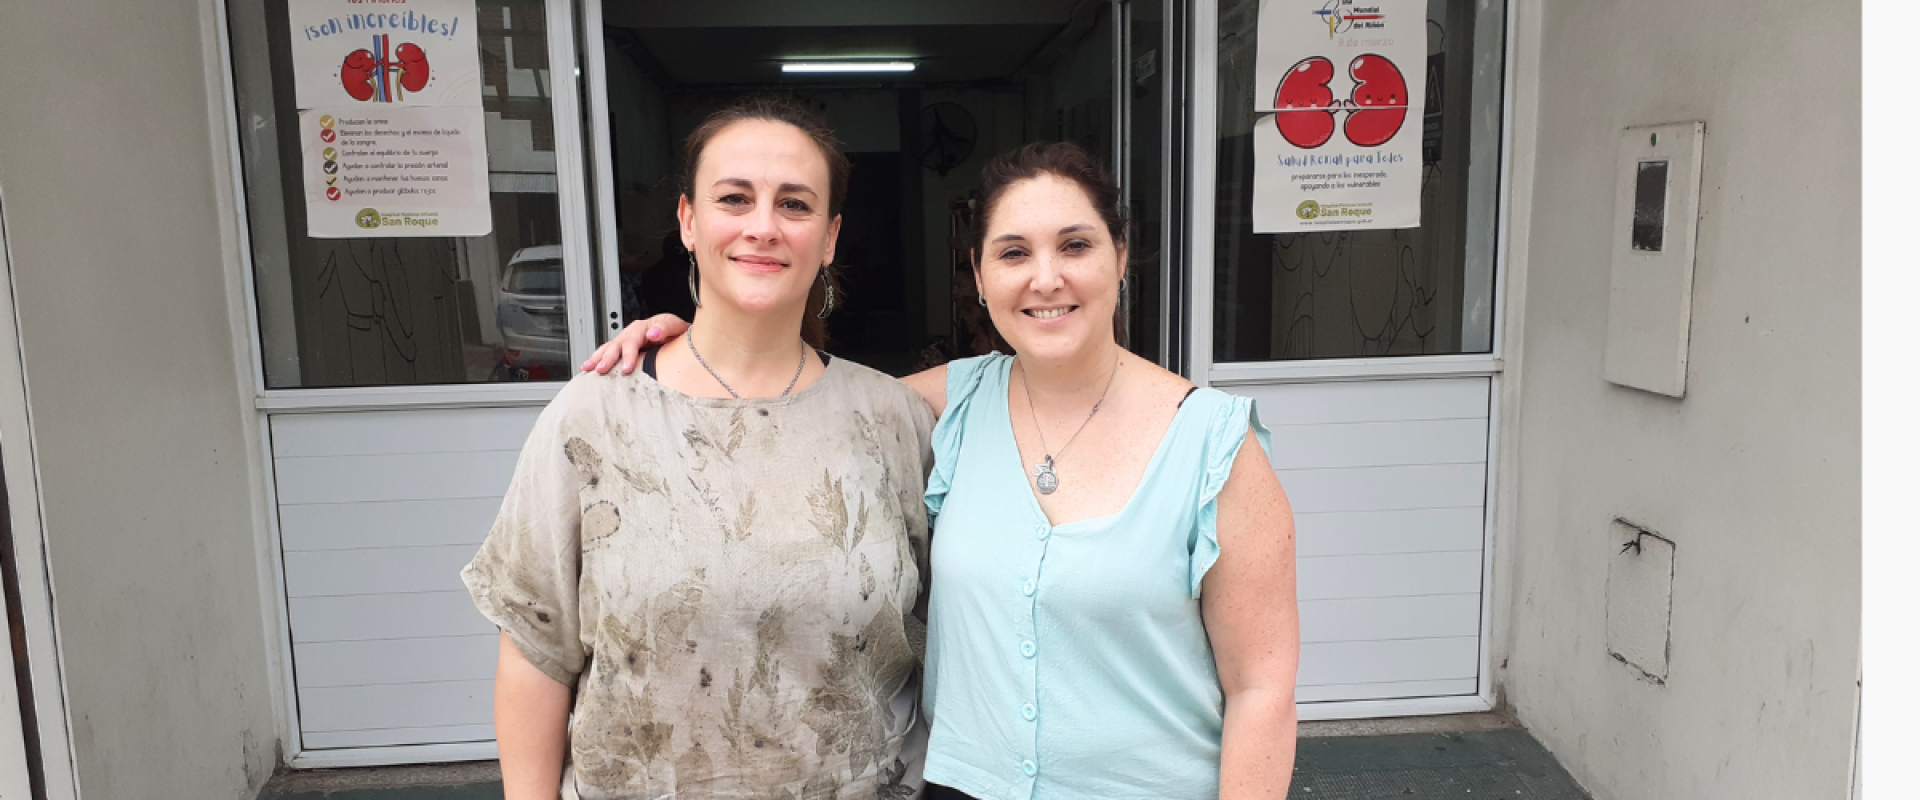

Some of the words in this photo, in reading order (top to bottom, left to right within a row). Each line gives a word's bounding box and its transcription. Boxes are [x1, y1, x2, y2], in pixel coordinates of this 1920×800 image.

[1346, 37, 1359, 47] de
[1361, 38, 1395, 47] marzo
[1346, 154, 1374, 167] para
[343, 162, 363, 171] Ayudan
[344, 175, 365, 184] Ayudan
[1291, 174, 1326, 182] prepararse
[1327, 173, 1342, 181] para
[1300, 182, 1330, 192] apoyando
[345, 188, 366, 197] Ayudan
[1321, 208, 1339, 217] San
[1341, 207, 1372, 218] Roque
[382, 217, 402, 226] San
[404, 217, 439, 228] Roque
